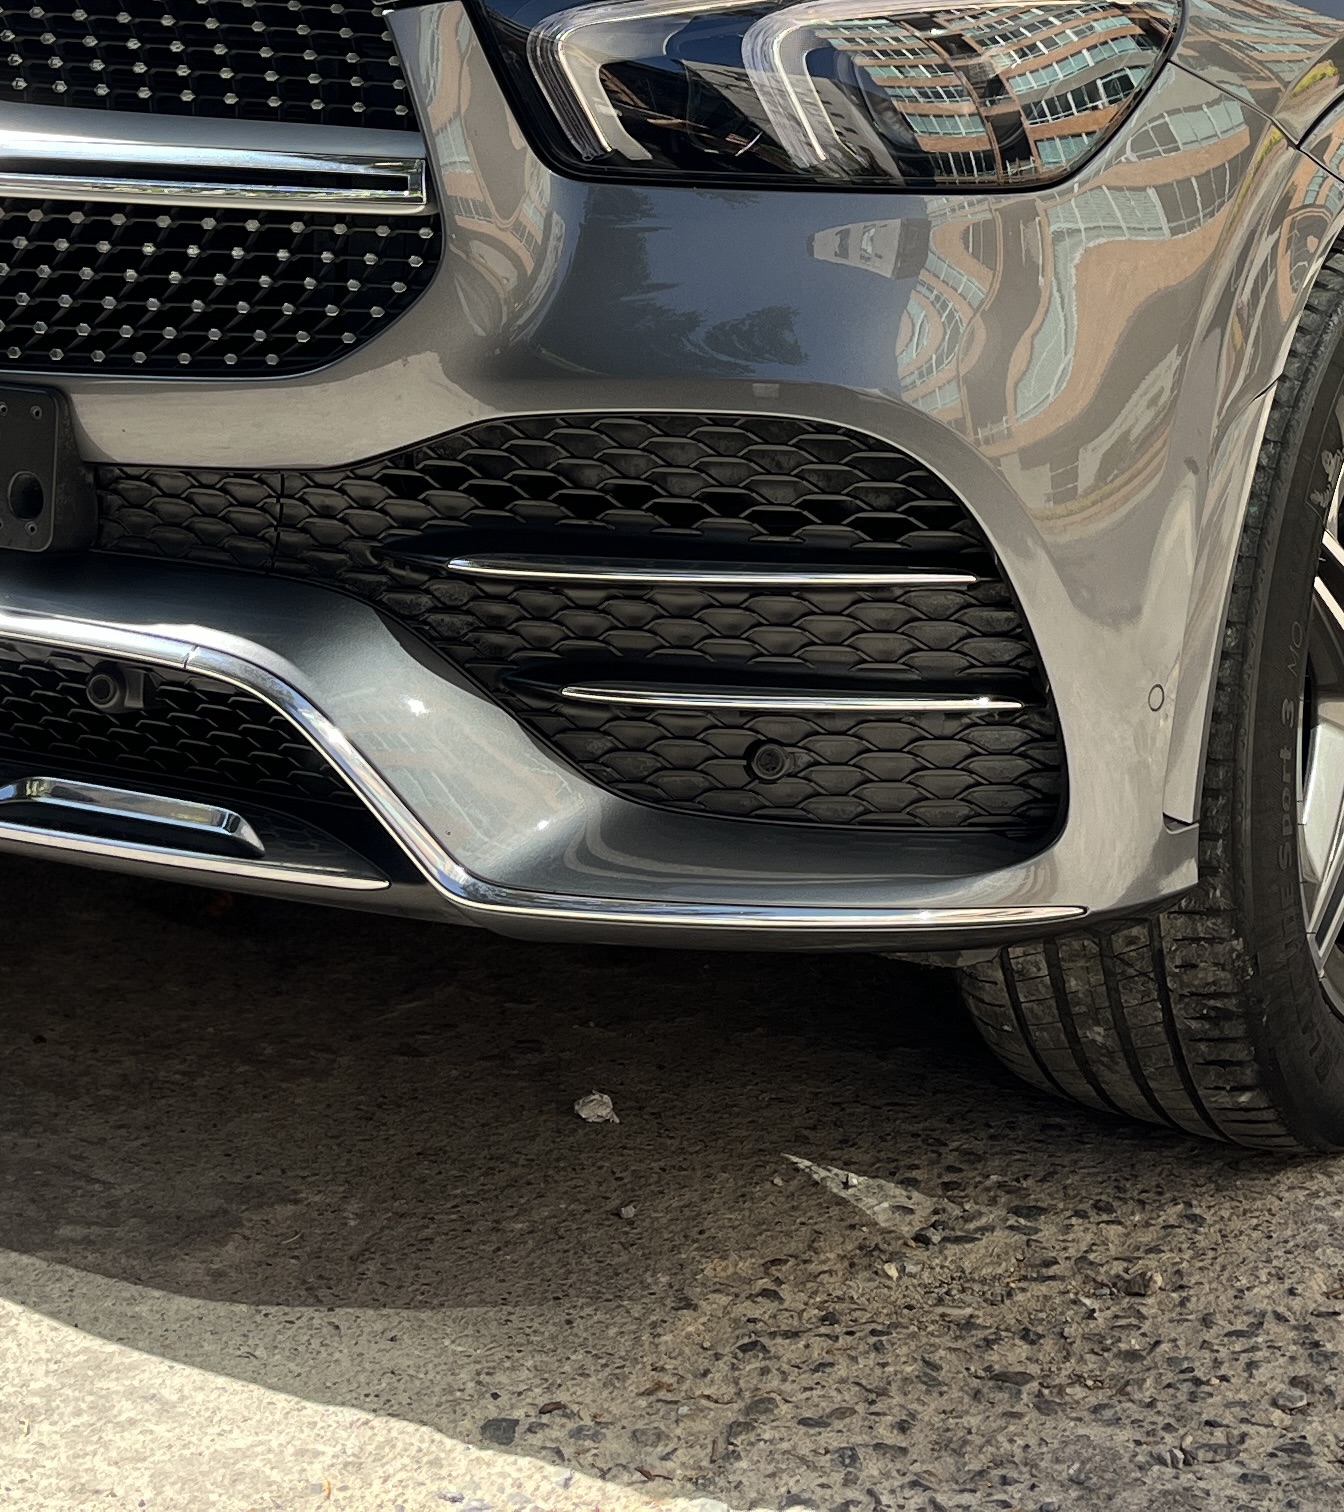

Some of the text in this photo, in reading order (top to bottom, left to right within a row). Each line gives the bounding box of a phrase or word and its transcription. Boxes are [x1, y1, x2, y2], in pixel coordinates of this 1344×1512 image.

[1287, 620, 1303, 678] MO
[1281, 698, 1295, 728] 3
[1278, 745, 1294, 871] Sport
